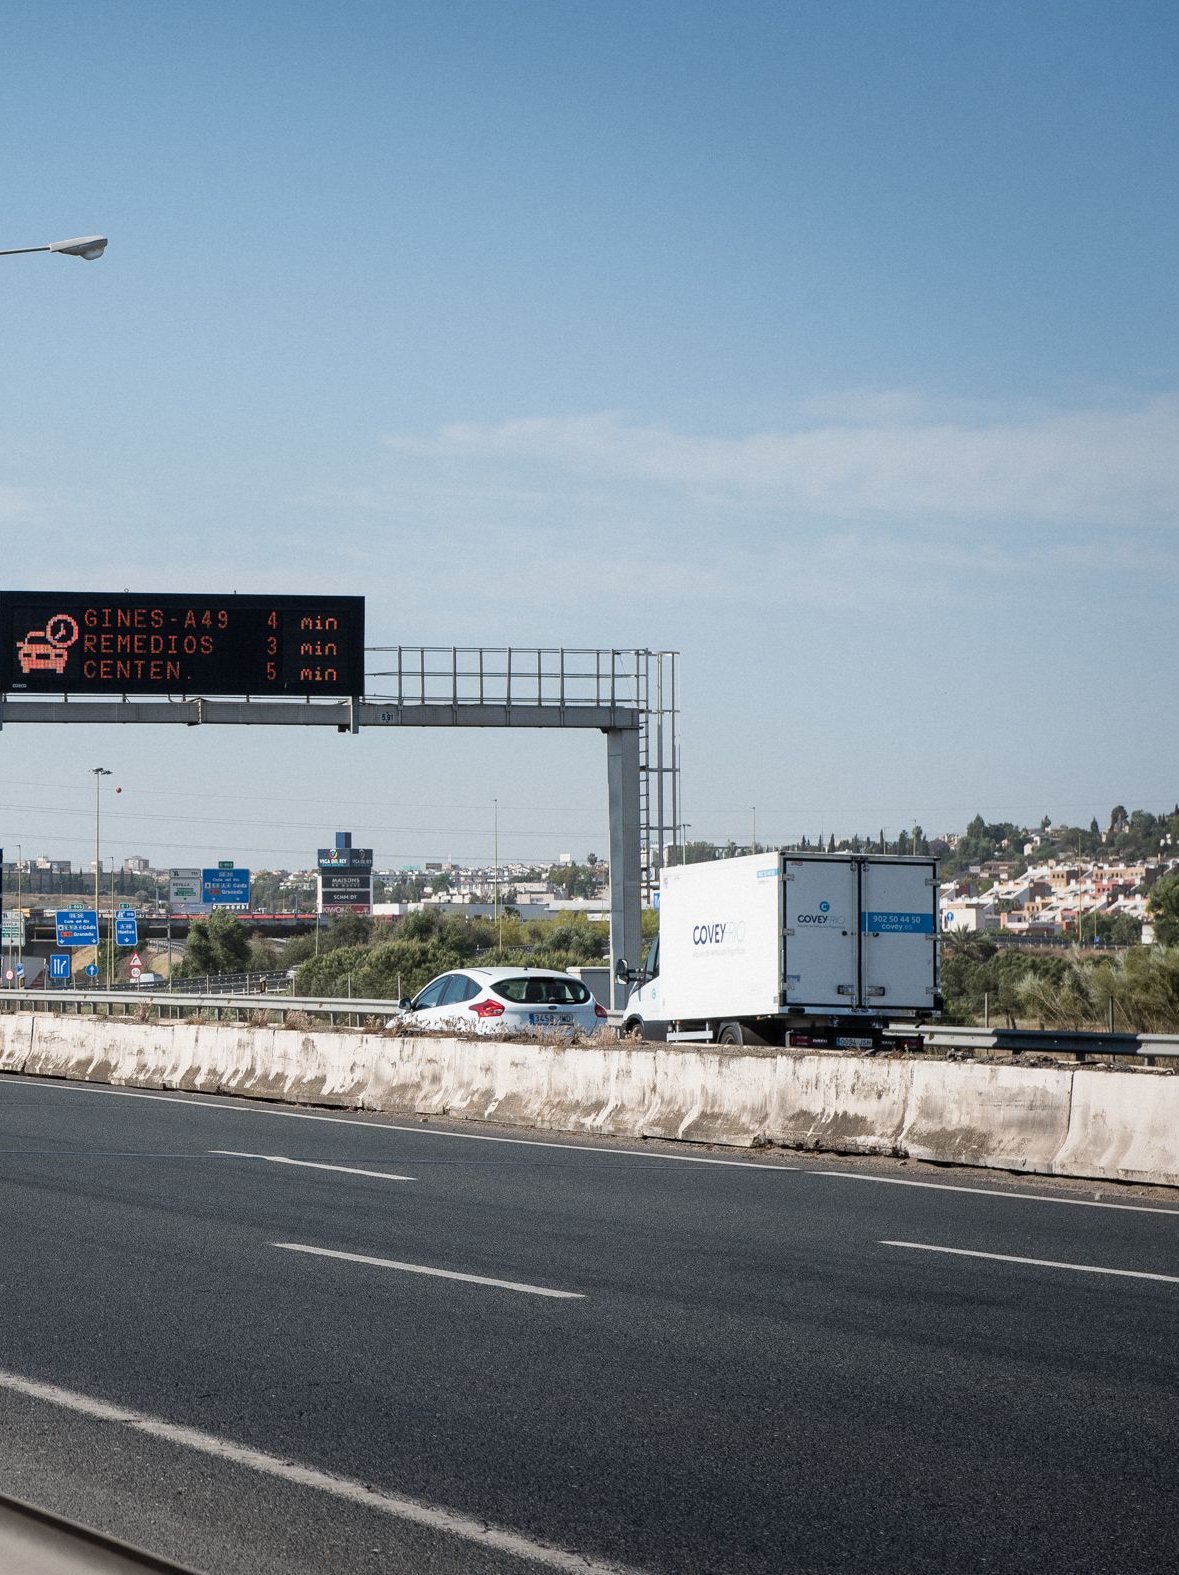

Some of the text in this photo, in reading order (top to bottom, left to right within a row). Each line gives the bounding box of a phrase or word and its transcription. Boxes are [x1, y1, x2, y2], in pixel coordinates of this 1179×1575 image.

[84, 609, 338, 630] GINES-A49 4 min
[83, 635, 337, 655] REMEDIOS 3 min
[83, 660, 336, 681] CENTEN. 5 min
